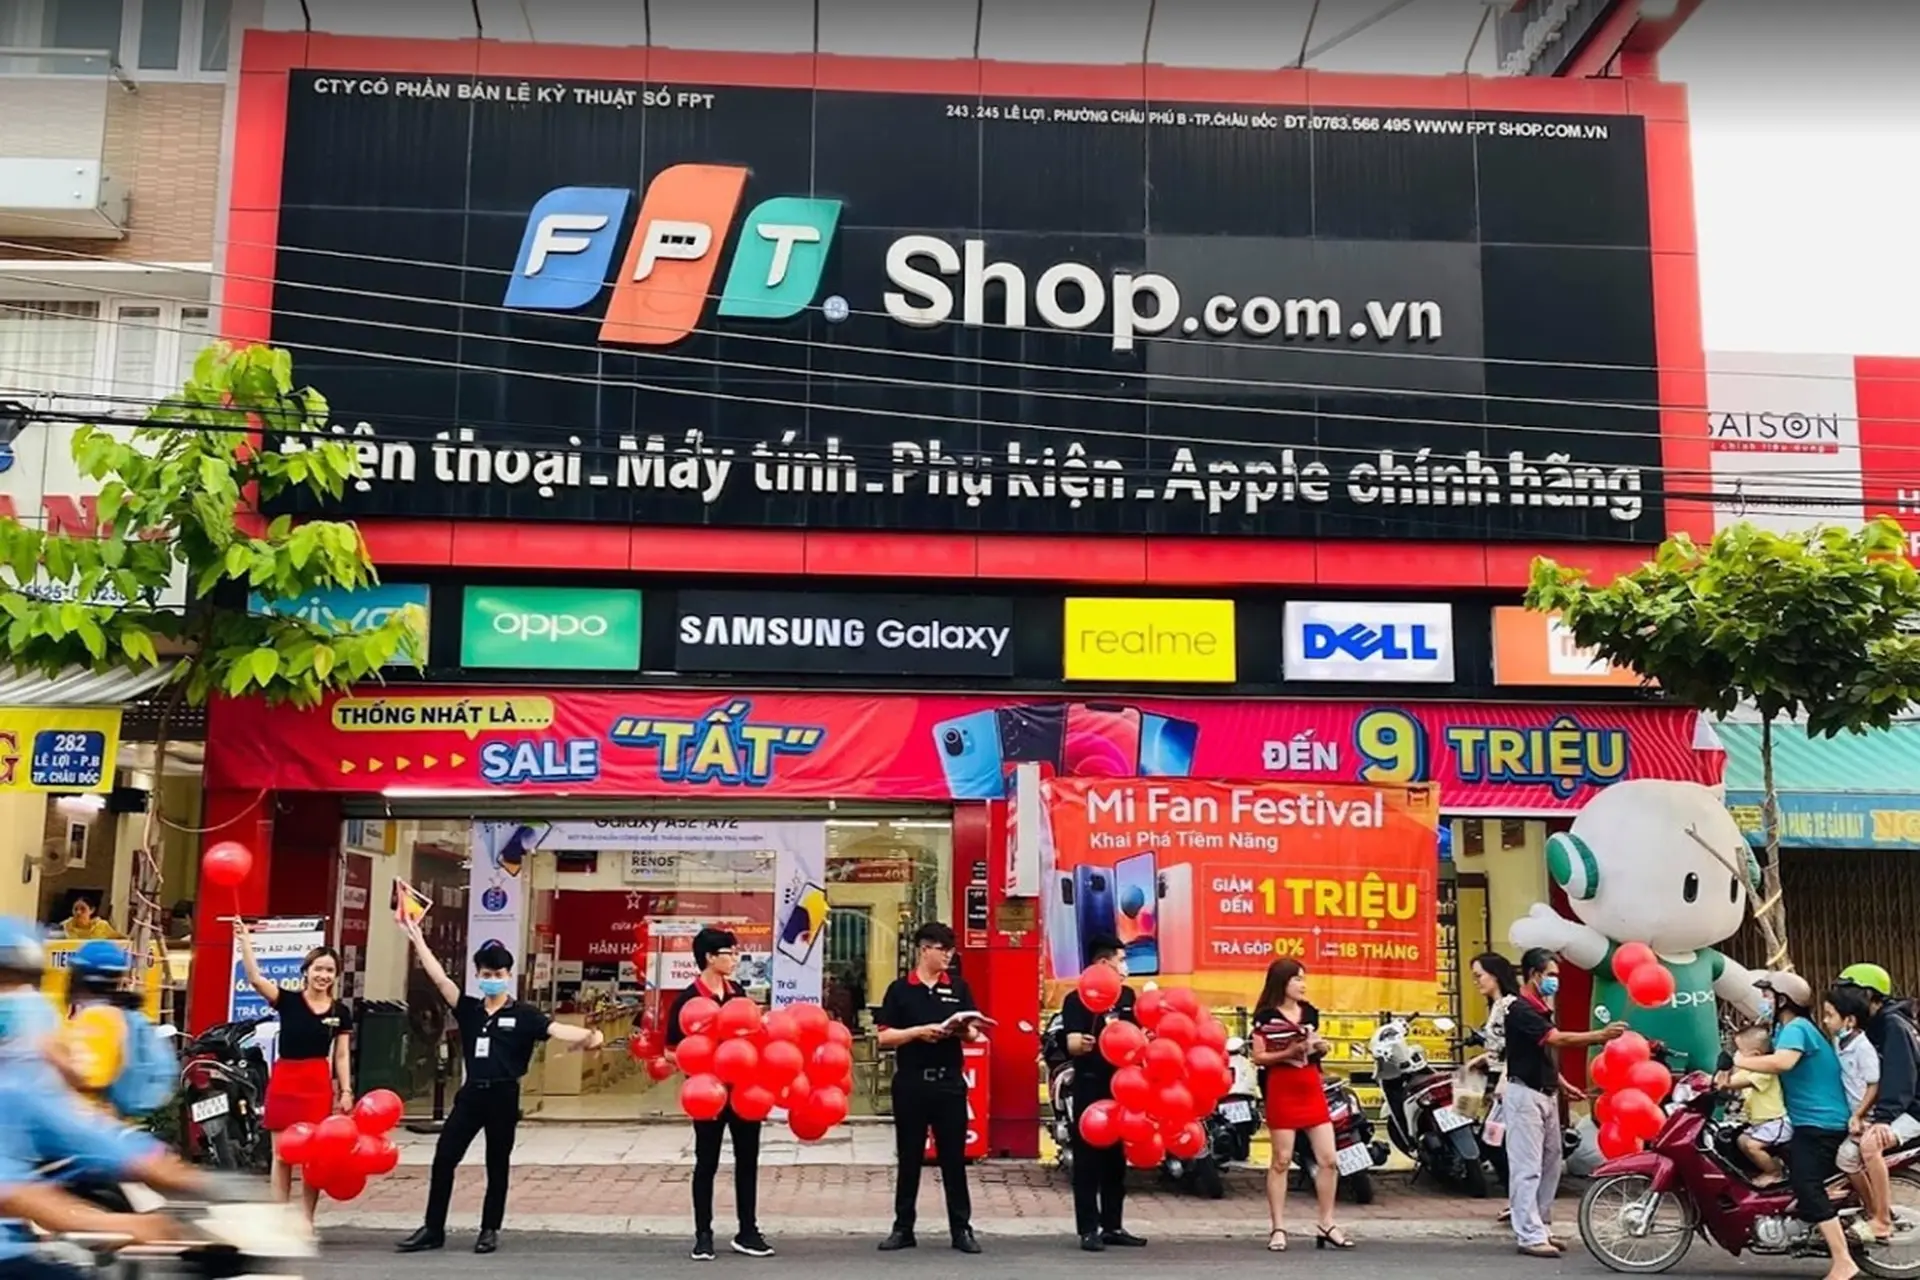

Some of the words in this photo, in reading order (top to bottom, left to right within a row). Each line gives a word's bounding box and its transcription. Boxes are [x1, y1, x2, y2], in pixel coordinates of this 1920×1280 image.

[314, 78, 356, 94] CTY
[677, 92, 714, 109] FPT
[1004, 104, 1020, 120] LÊ
[1053, 107, 1108, 123] PHƯỜNG
[1111, 107, 1145, 124] CHÂU
[1149, 108, 1174, 125] PHÚ
[1499, 122, 1608, 140] SHOP.COM.VN
[884, 234, 1442, 352] Shop.com.vn
[432, 427, 581, 498] thoại
[752, 430, 859, 494] tính
[892, 439, 993, 507] Phụ
[1006, 441, 1126, 508] kiện
[1161, 446, 1331, 515] Apple
[1347, 446, 1500, 507] chính
[1508, 448, 1643, 522] hãng
[492, 612, 607, 642] oppo
[680, 615, 865, 647] SAMSUNG
[876, 619, 1012, 657] Galaxy
[1079, 623, 1218, 657] realme
[1303, 623, 1438, 662] DELL
[338, 700, 416, 725] THỐNG
[421, 699, 484, 724] NHẤT
[53, 733, 87, 753] 282
[1262, 728, 1338, 773] ĐẾN
[1355, 708, 1430, 783] 9
[1446, 714, 1630, 799] TRIỆU
[34, 752, 49, 767] LÊ
[52, 753, 70, 769] LỢI
[80, 755, 100, 767] P.B
[49, 770, 75, 783] CHÂU
[78, 768, 99, 784] ĐỐC
[480, 741, 598, 782] SALE
[1088, 790, 1135, 824] Mi
[1147, 789, 1221, 825] Fan
[1231, 790, 1385, 829] Festival
[1090, 831, 1131, 849] Khai
[1137, 831, 1172, 849] Phá
[1228, 831, 1279, 852] Năng
[1212, 874, 1254, 893] GIẢM
[1220, 894, 1254, 914] ĐẾN
[1258, 877, 1276, 916] 1
[1284, 872, 1417, 929] TRIỆU
[1211, 938, 1242, 955] TRẢ
[1243, 939, 1273, 956] GÓP
[1274, 937, 1305, 957] 0%
[1361, 941, 1420, 960] THÁNG
